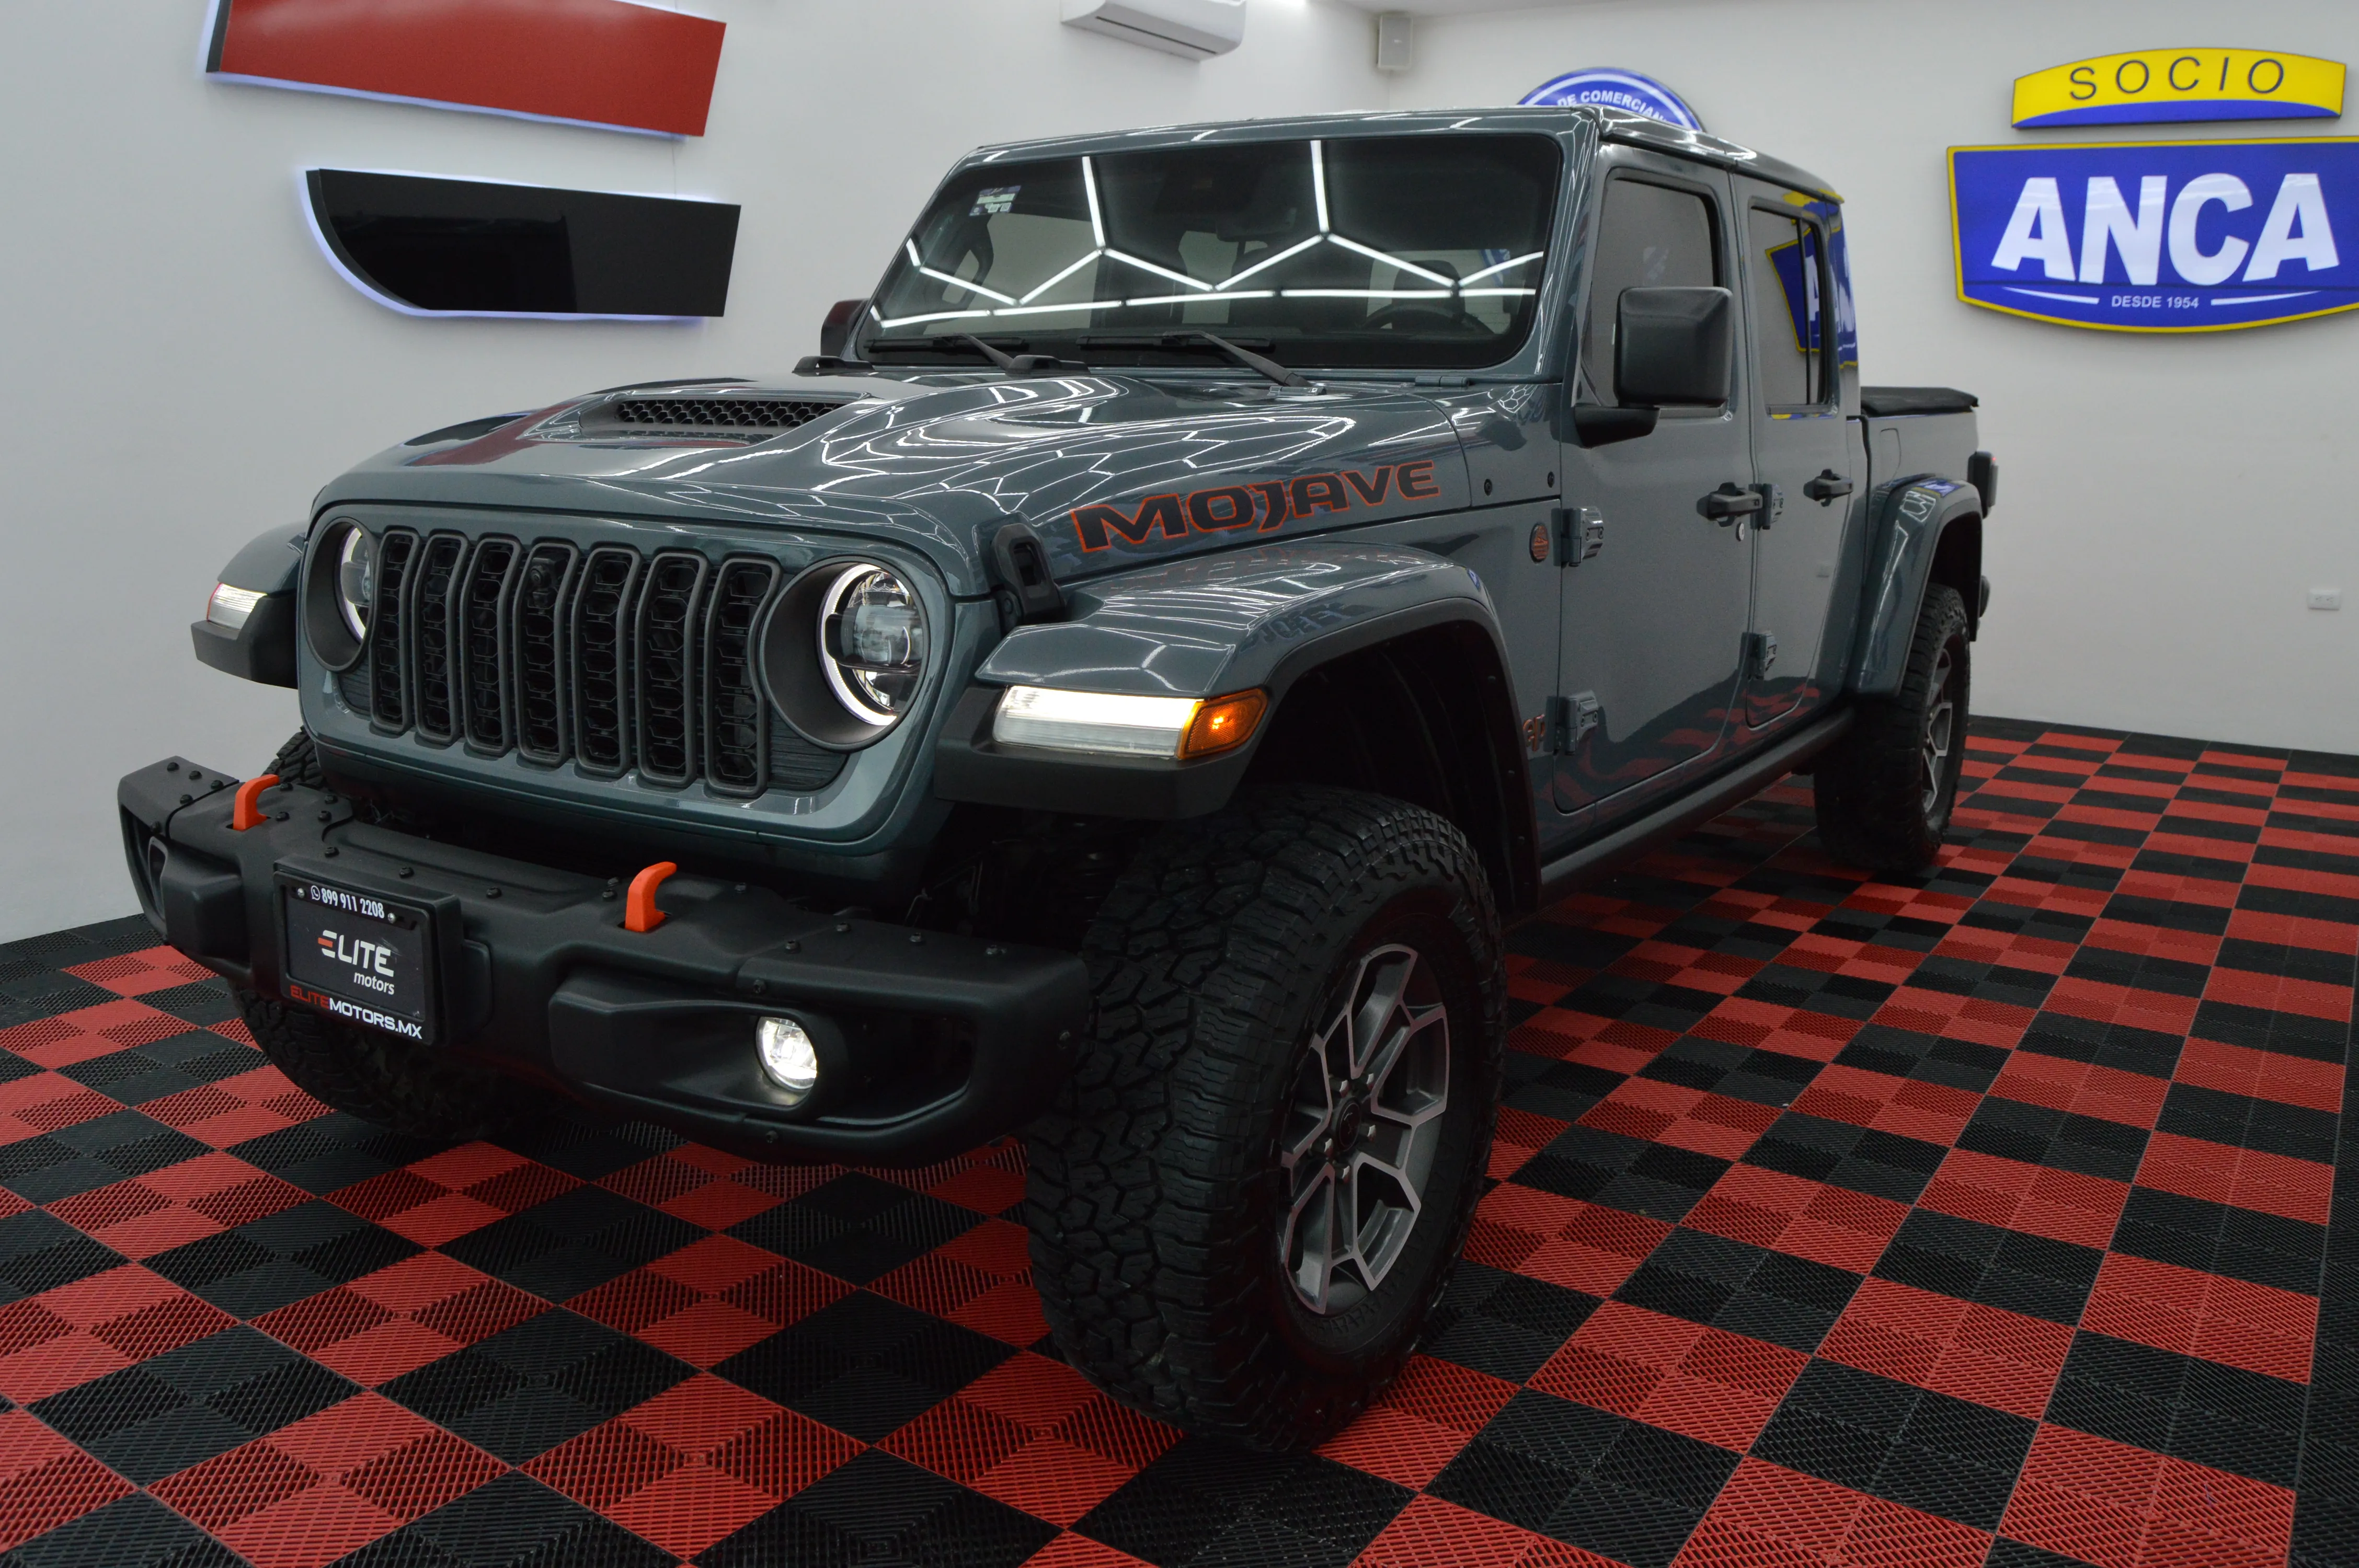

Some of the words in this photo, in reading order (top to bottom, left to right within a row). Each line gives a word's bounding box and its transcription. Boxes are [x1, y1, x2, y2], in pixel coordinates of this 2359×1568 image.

[2069, 56, 2285, 101] SOCIO
[1990, 173, 2340, 286] ANCA
[2111, 295, 2162, 308] DESDE
[2167, 297, 2199, 308] 1954
[1070, 460, 1440, 553] MOJAVE
[321, 888, 338, 906] 899
[340, 893, 358, 912] 911
[360, 898, 385, 918] 2208
[318, 930, 394, 977] ELITE
[353, 972, 395, 995] motors
[290, 985, 422, 1040] ELITEMOTORS.MX
